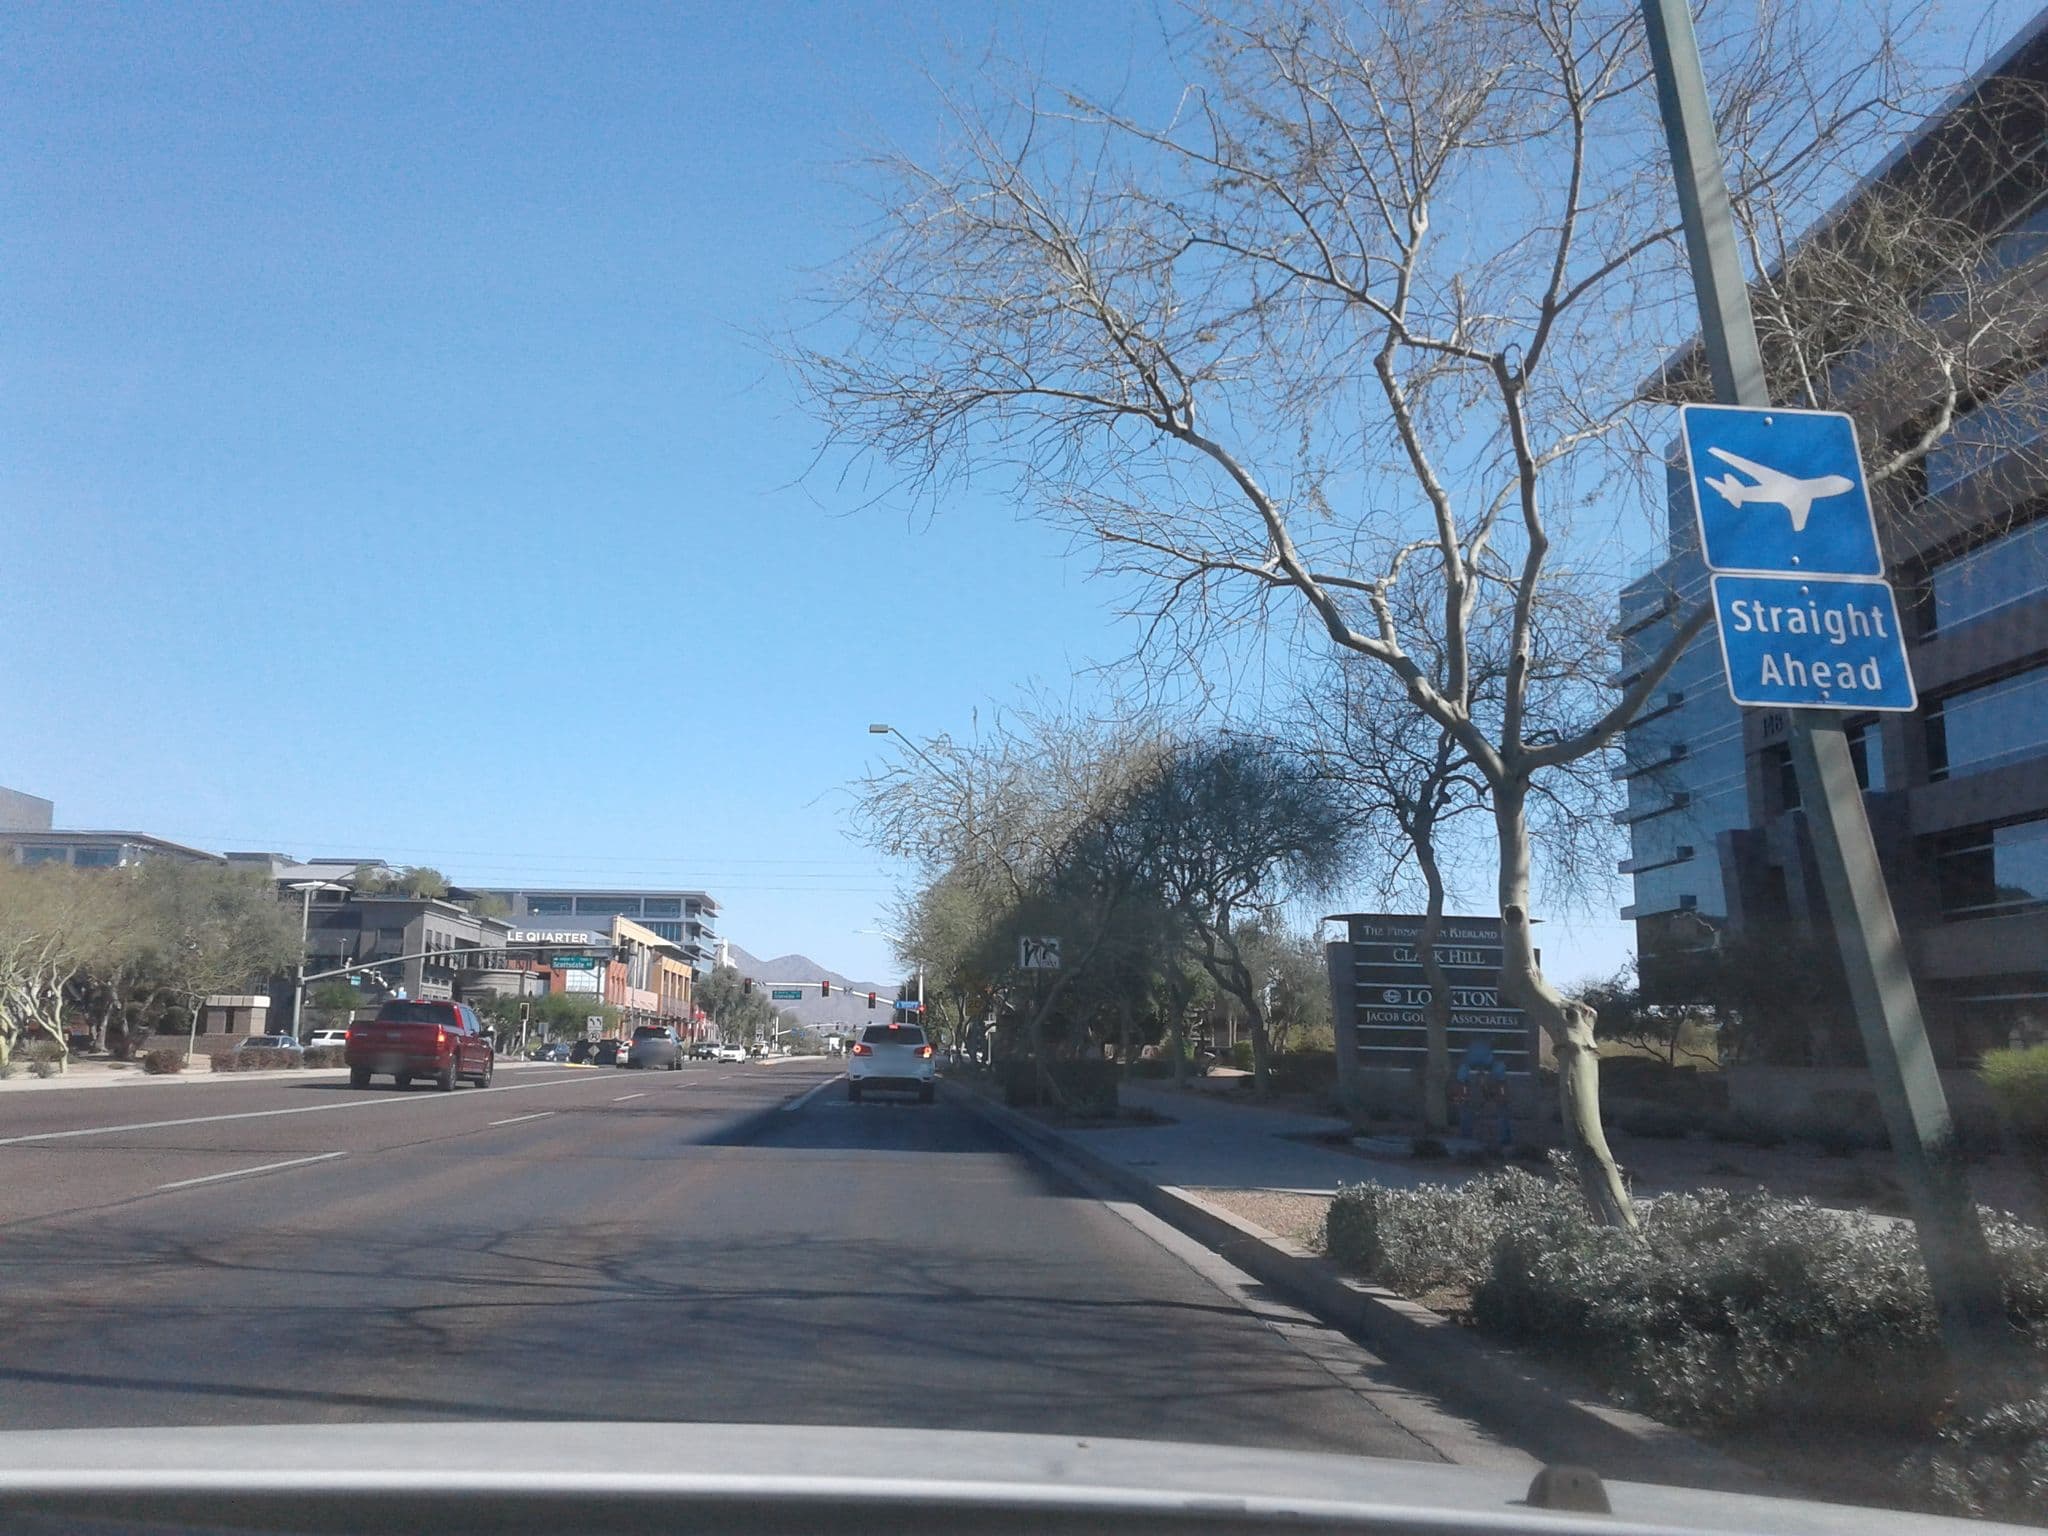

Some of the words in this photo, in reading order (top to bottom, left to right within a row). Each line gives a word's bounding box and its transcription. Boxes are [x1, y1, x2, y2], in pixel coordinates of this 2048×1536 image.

[1730, 600, 1889, 645] Straight
[1761, 652, 1882, 691] Ahead
[507, 931, 523, 942] LE
[526, 932, 588, 943] QUARTER
[1448, 949, 1486, 964] HILL
[1366, 1010, 1400, 1024] JACOB
[1450, 1013, 1513, 1026] ASSOCIATES
